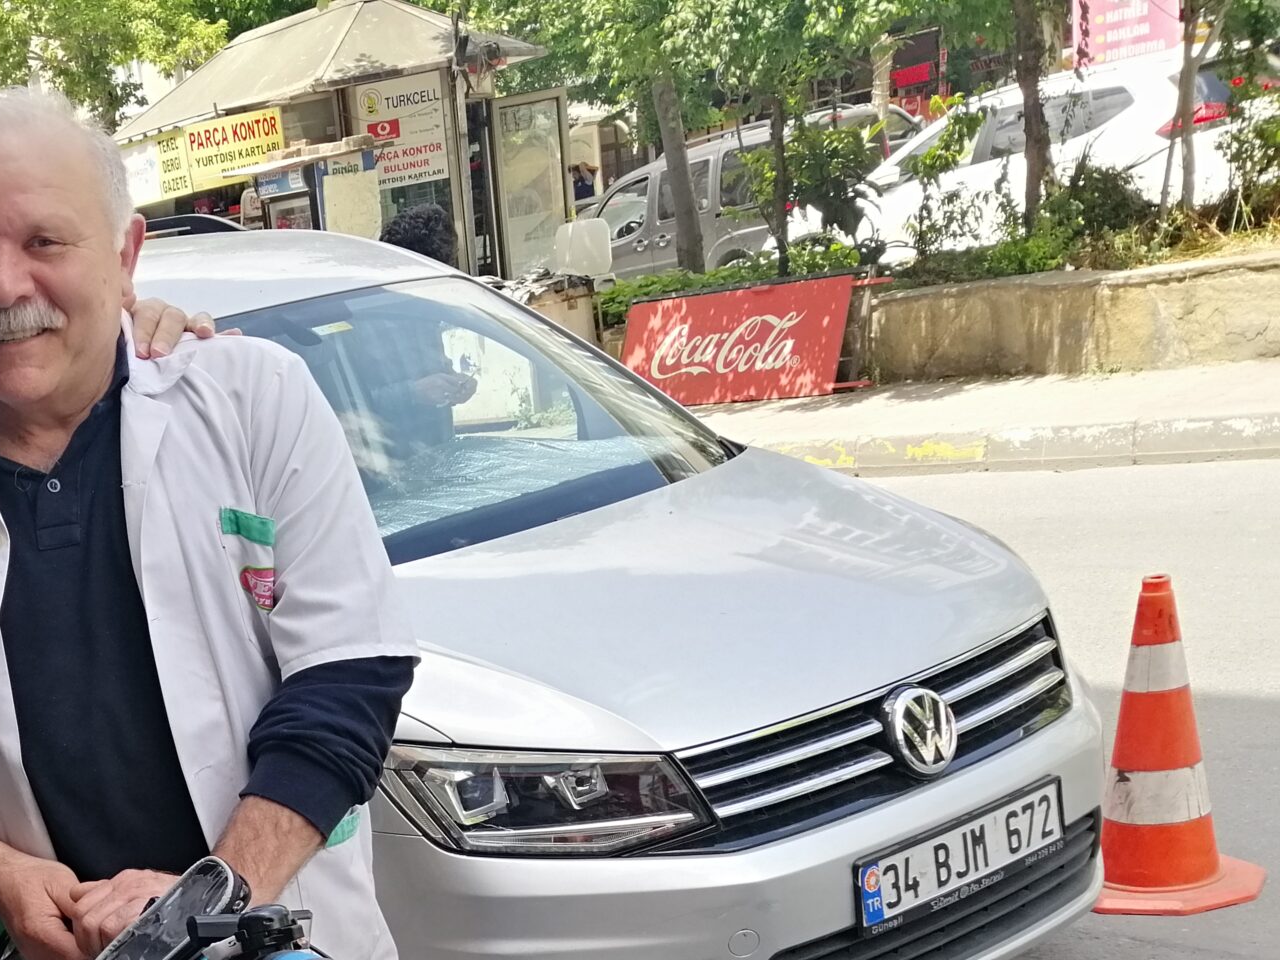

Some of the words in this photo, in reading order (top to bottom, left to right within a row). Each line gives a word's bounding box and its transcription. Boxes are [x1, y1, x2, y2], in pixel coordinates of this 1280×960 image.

[384, 88, 440, 110] TURKCELL
[189, 125, 229, 151] PARÇA
[231, 114, 278, 143] KONTÖR
[158, 137, 179, 154] TEKEL
[195, 150, 236, 168] YURTDIŞI
[238, 142, 280, 159] KARTLARI
[374, 149, 400, 163] ARÇA
[402, 142, 443, 158] KONTÖR
[383, 158, 430, 174] BULUNUR
[407, 168, 445, 182] KARTLARI
[162, 175, 188, 194] GAZETE
[651, 310, 807, 379] Coca-Cola
[883, 856, 921, 910] 34
[933, 823, 989, 889] BJM
[1005, 794, 1055, 855] 672
[866, 896, 882, 913] TR
